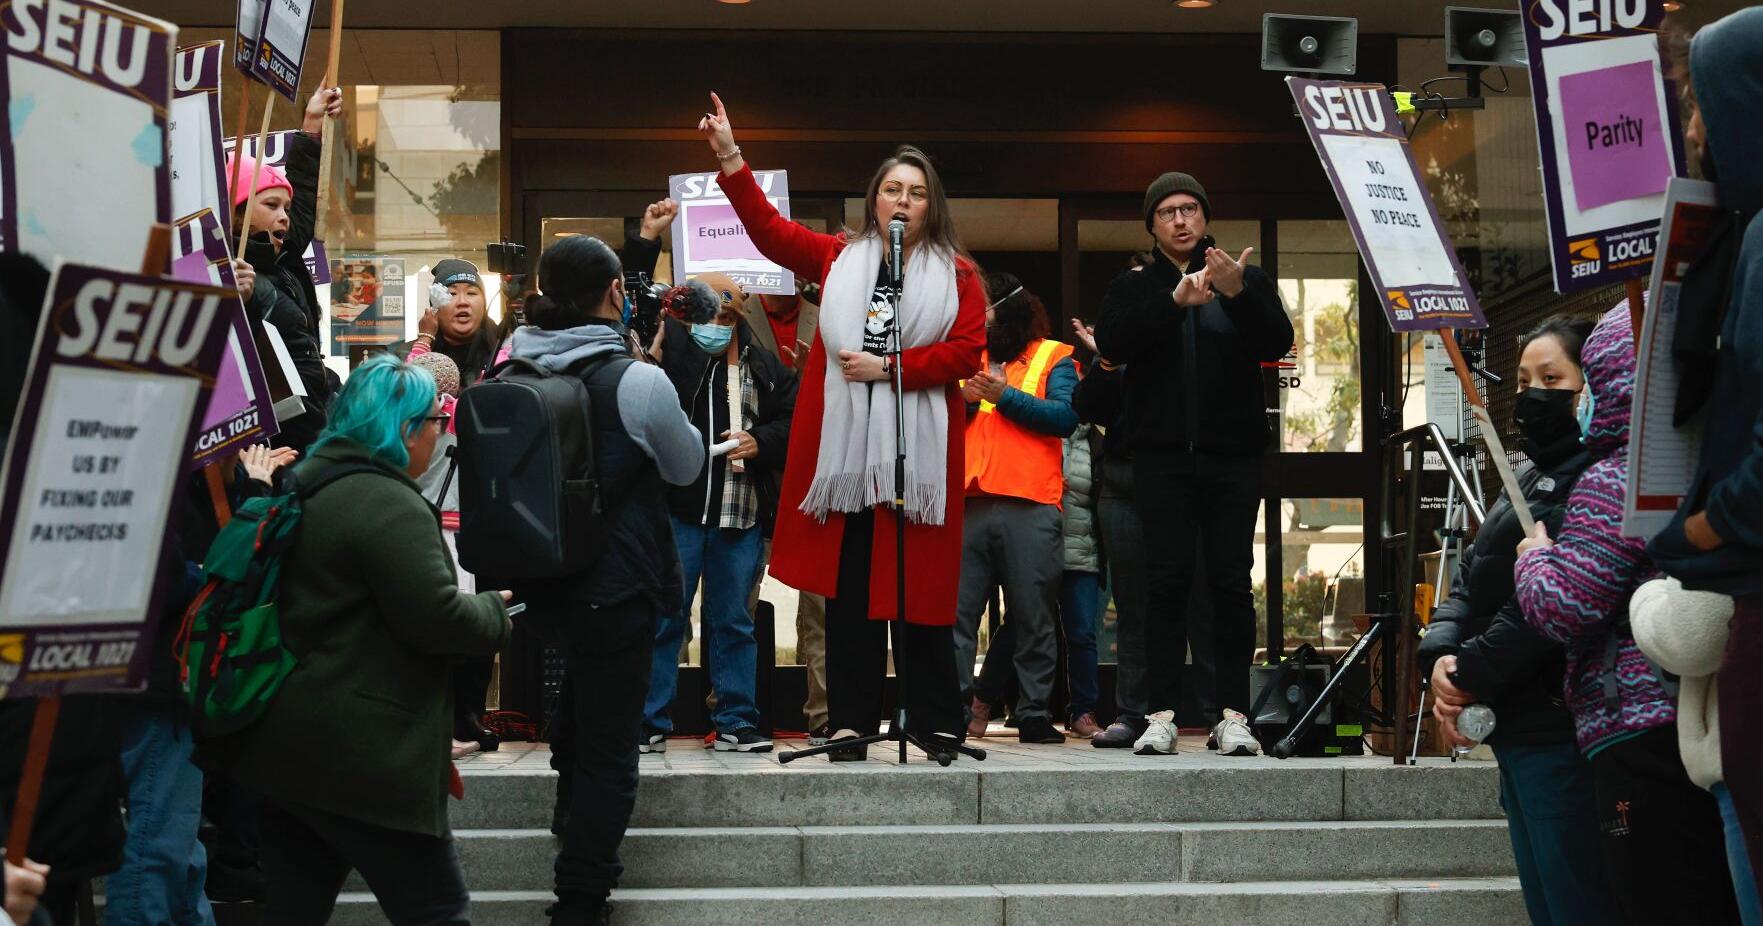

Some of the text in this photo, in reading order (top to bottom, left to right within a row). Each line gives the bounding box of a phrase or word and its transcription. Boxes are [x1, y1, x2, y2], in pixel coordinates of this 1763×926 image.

[8, 0, 151, 87] SEIU
[270, 57, 285, 78] LOCAL
[1304, 85, 1386, 132] SEIU
[1585, 115, 1644, 150] Parity
[1366, 160, 1385, 175] NO
[1365, 183, 1408, 201] JUSTICE
[1372, 208, 1421, 228] NO PEACE
[698, 224, 748, 239] Equali
[1608, 237, 1652, 262] LOCAL
[1571, 261, 1600, 278] SEIU
[1413, 296, 1469, 312] LOCAL 1021
[56, 277, 222, 367] SEIU
[1395, 309, 1414, 320] SEIU
[194, 428, 226, 452] CAL
[229, 411, 259, 437] 1021
